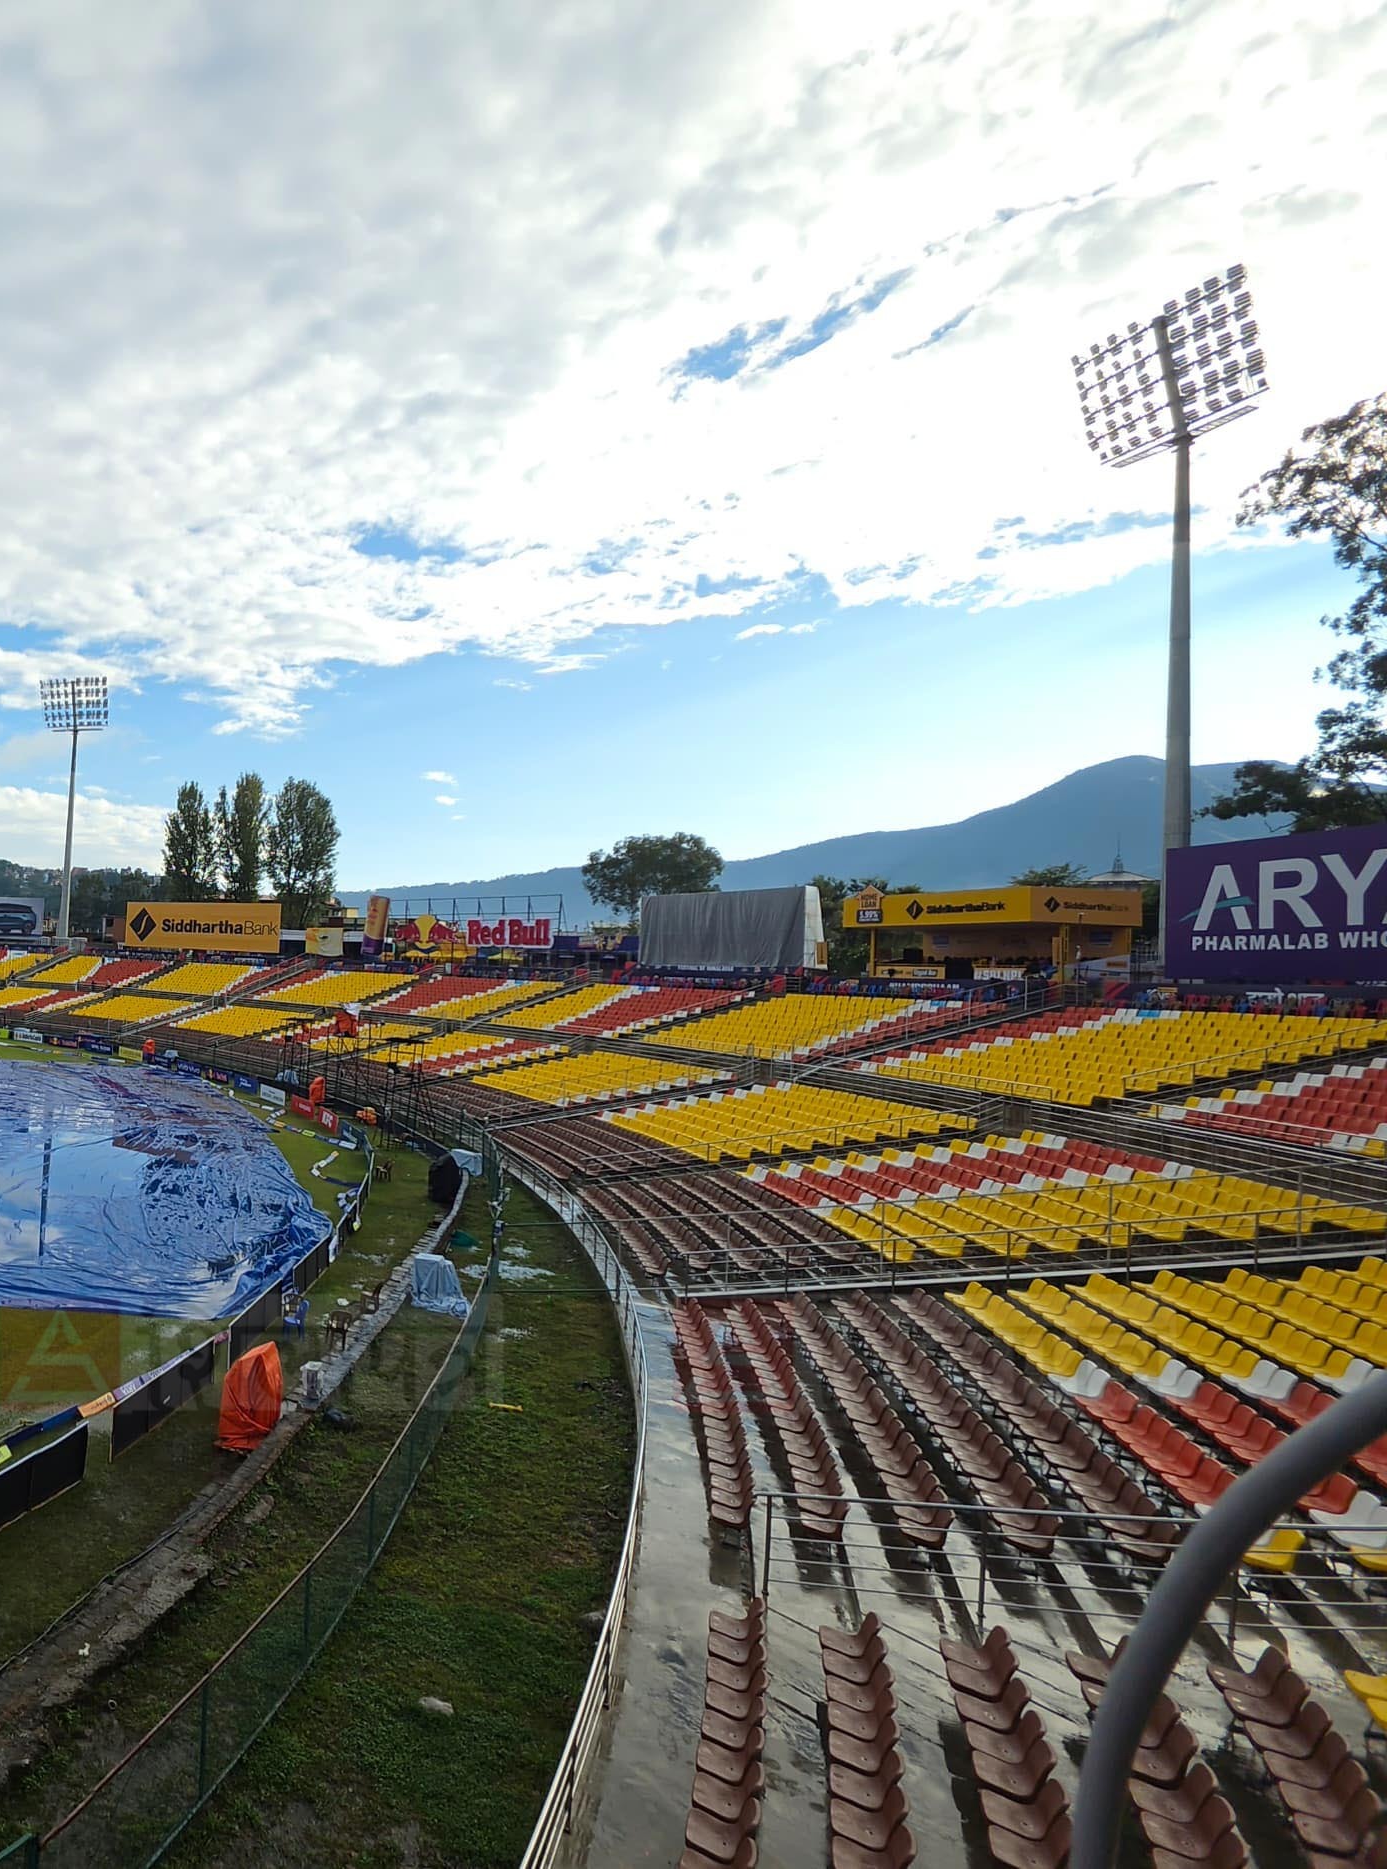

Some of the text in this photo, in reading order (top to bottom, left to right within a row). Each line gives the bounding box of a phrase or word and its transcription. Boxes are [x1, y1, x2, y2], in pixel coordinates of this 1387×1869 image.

[1191, 849, 1387, 932] ARY
[161, 917, 279, 936] SiddharthaBank
[467, 918, 552, 946] Red Bull
[1192, 932, 1329, 951] PHARMALAB
